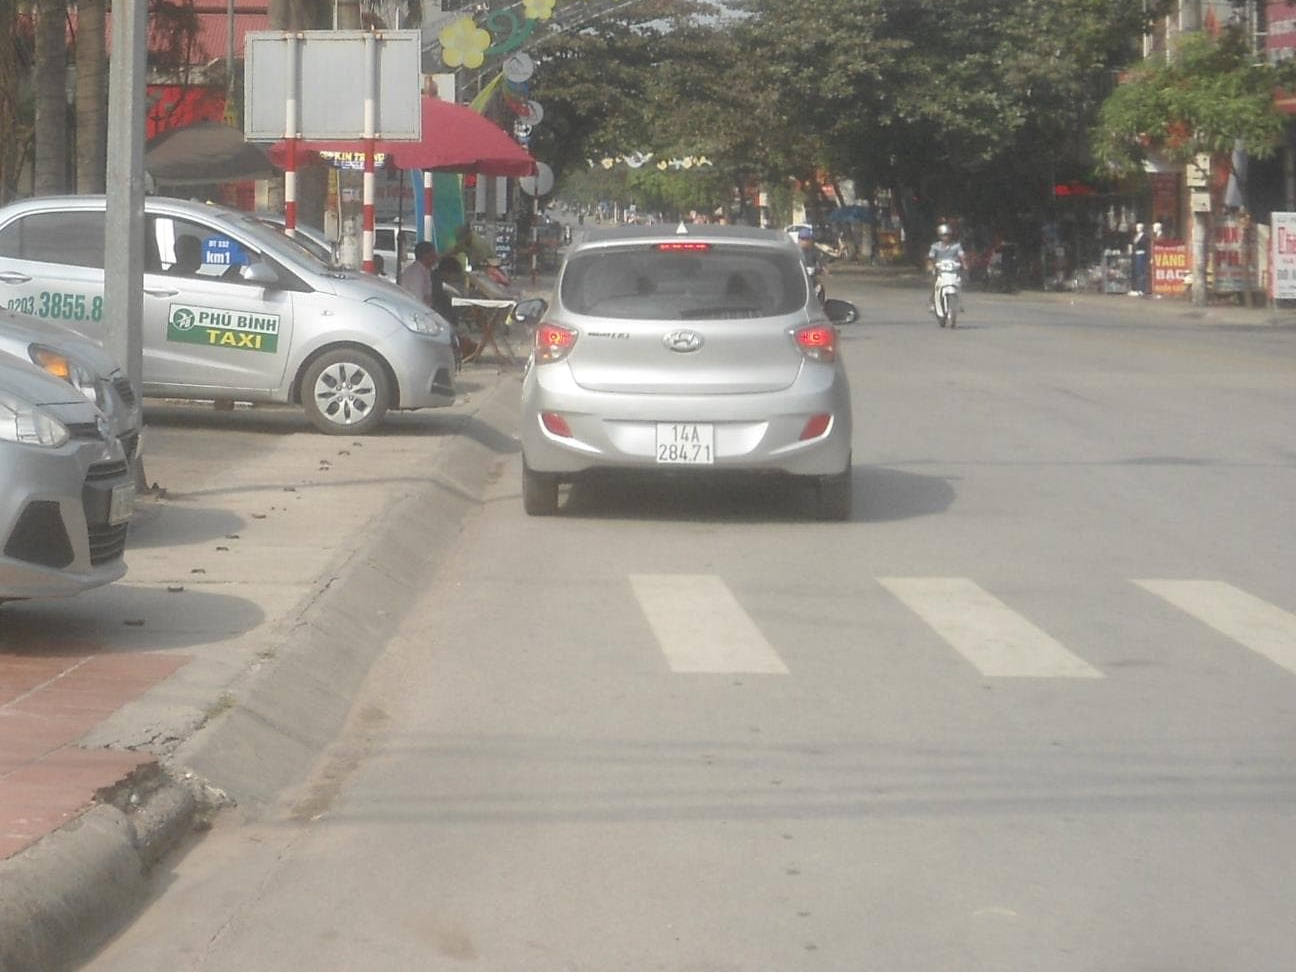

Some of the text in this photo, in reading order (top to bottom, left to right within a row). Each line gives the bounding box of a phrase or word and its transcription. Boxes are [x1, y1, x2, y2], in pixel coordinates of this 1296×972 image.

[206, 250, 231, 264] km1
[7, 291, 103, 322] 0203.3855.8
[198, 311, 278, 332] PHÚ BÌNH
[206, 329, 263, 349] TAXI
[672, 424, 701, 443] 14A
[658, 443, 711, 461] 284.71
